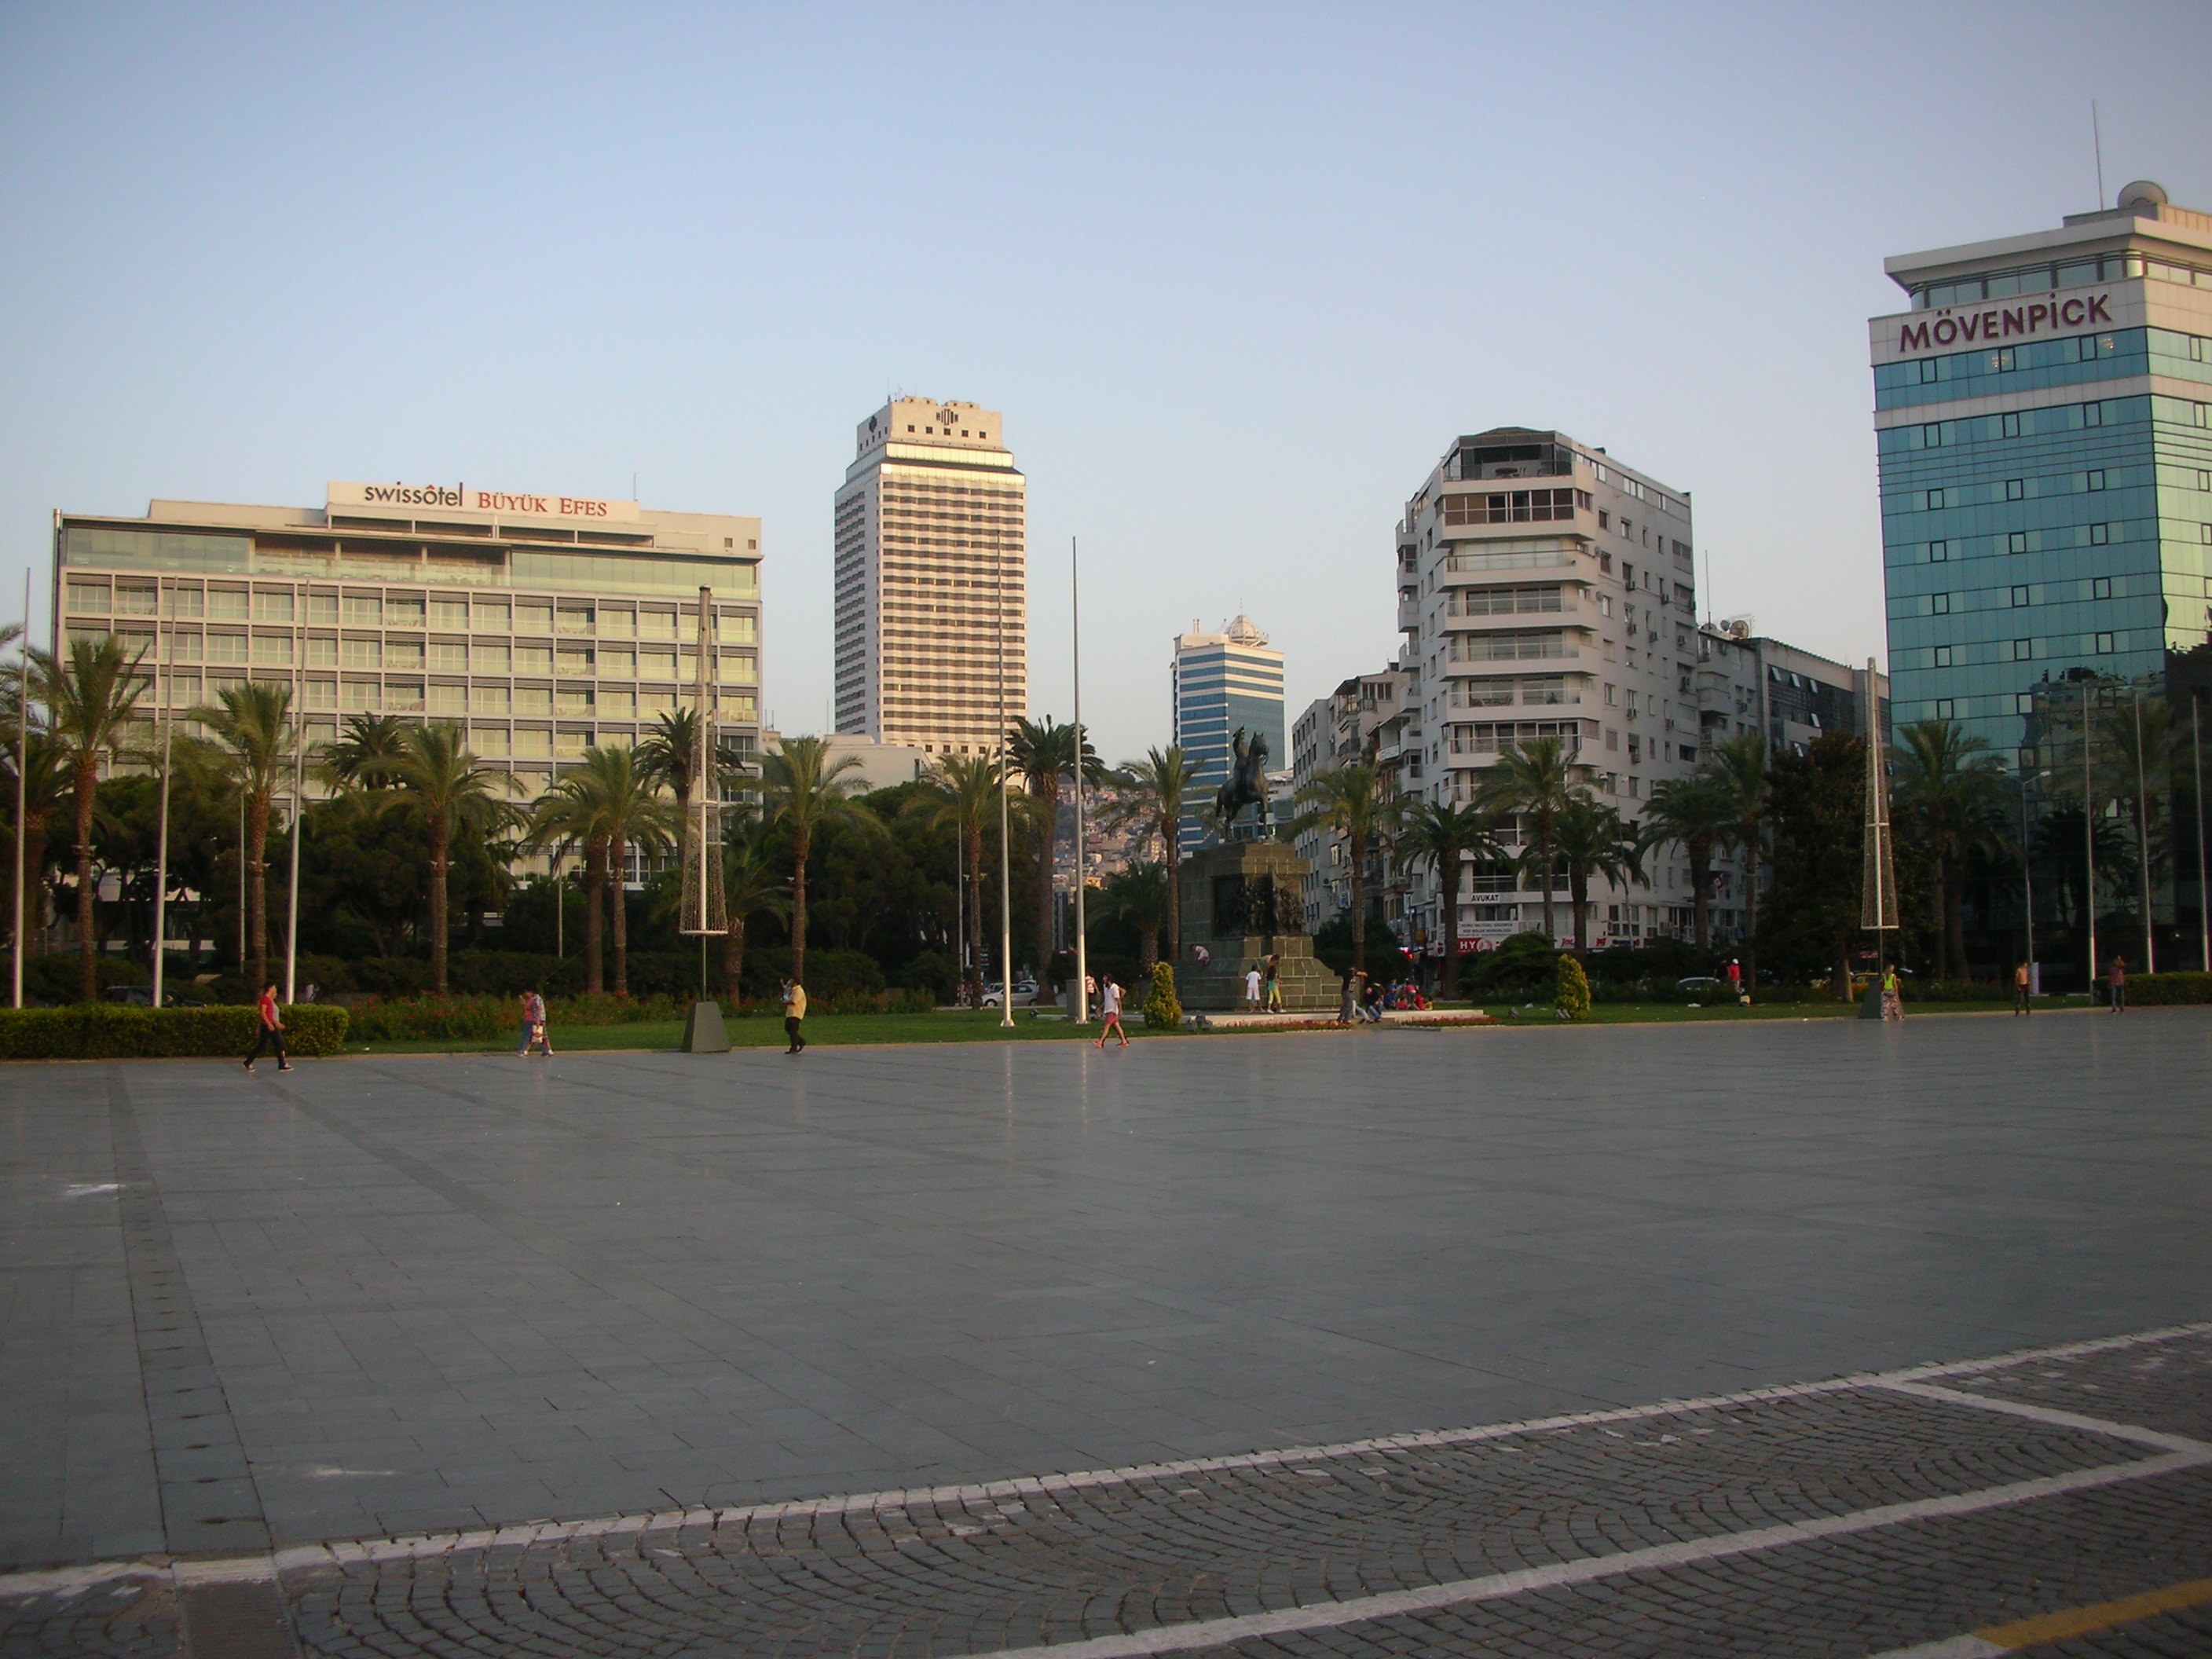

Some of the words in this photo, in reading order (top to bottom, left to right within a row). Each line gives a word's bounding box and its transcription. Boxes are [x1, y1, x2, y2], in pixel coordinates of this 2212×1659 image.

[364, 481, 463, 507] swissôtel
[478, 491, 548, 514] BÜYÜK
[559, 496, 607, 517] EFES
